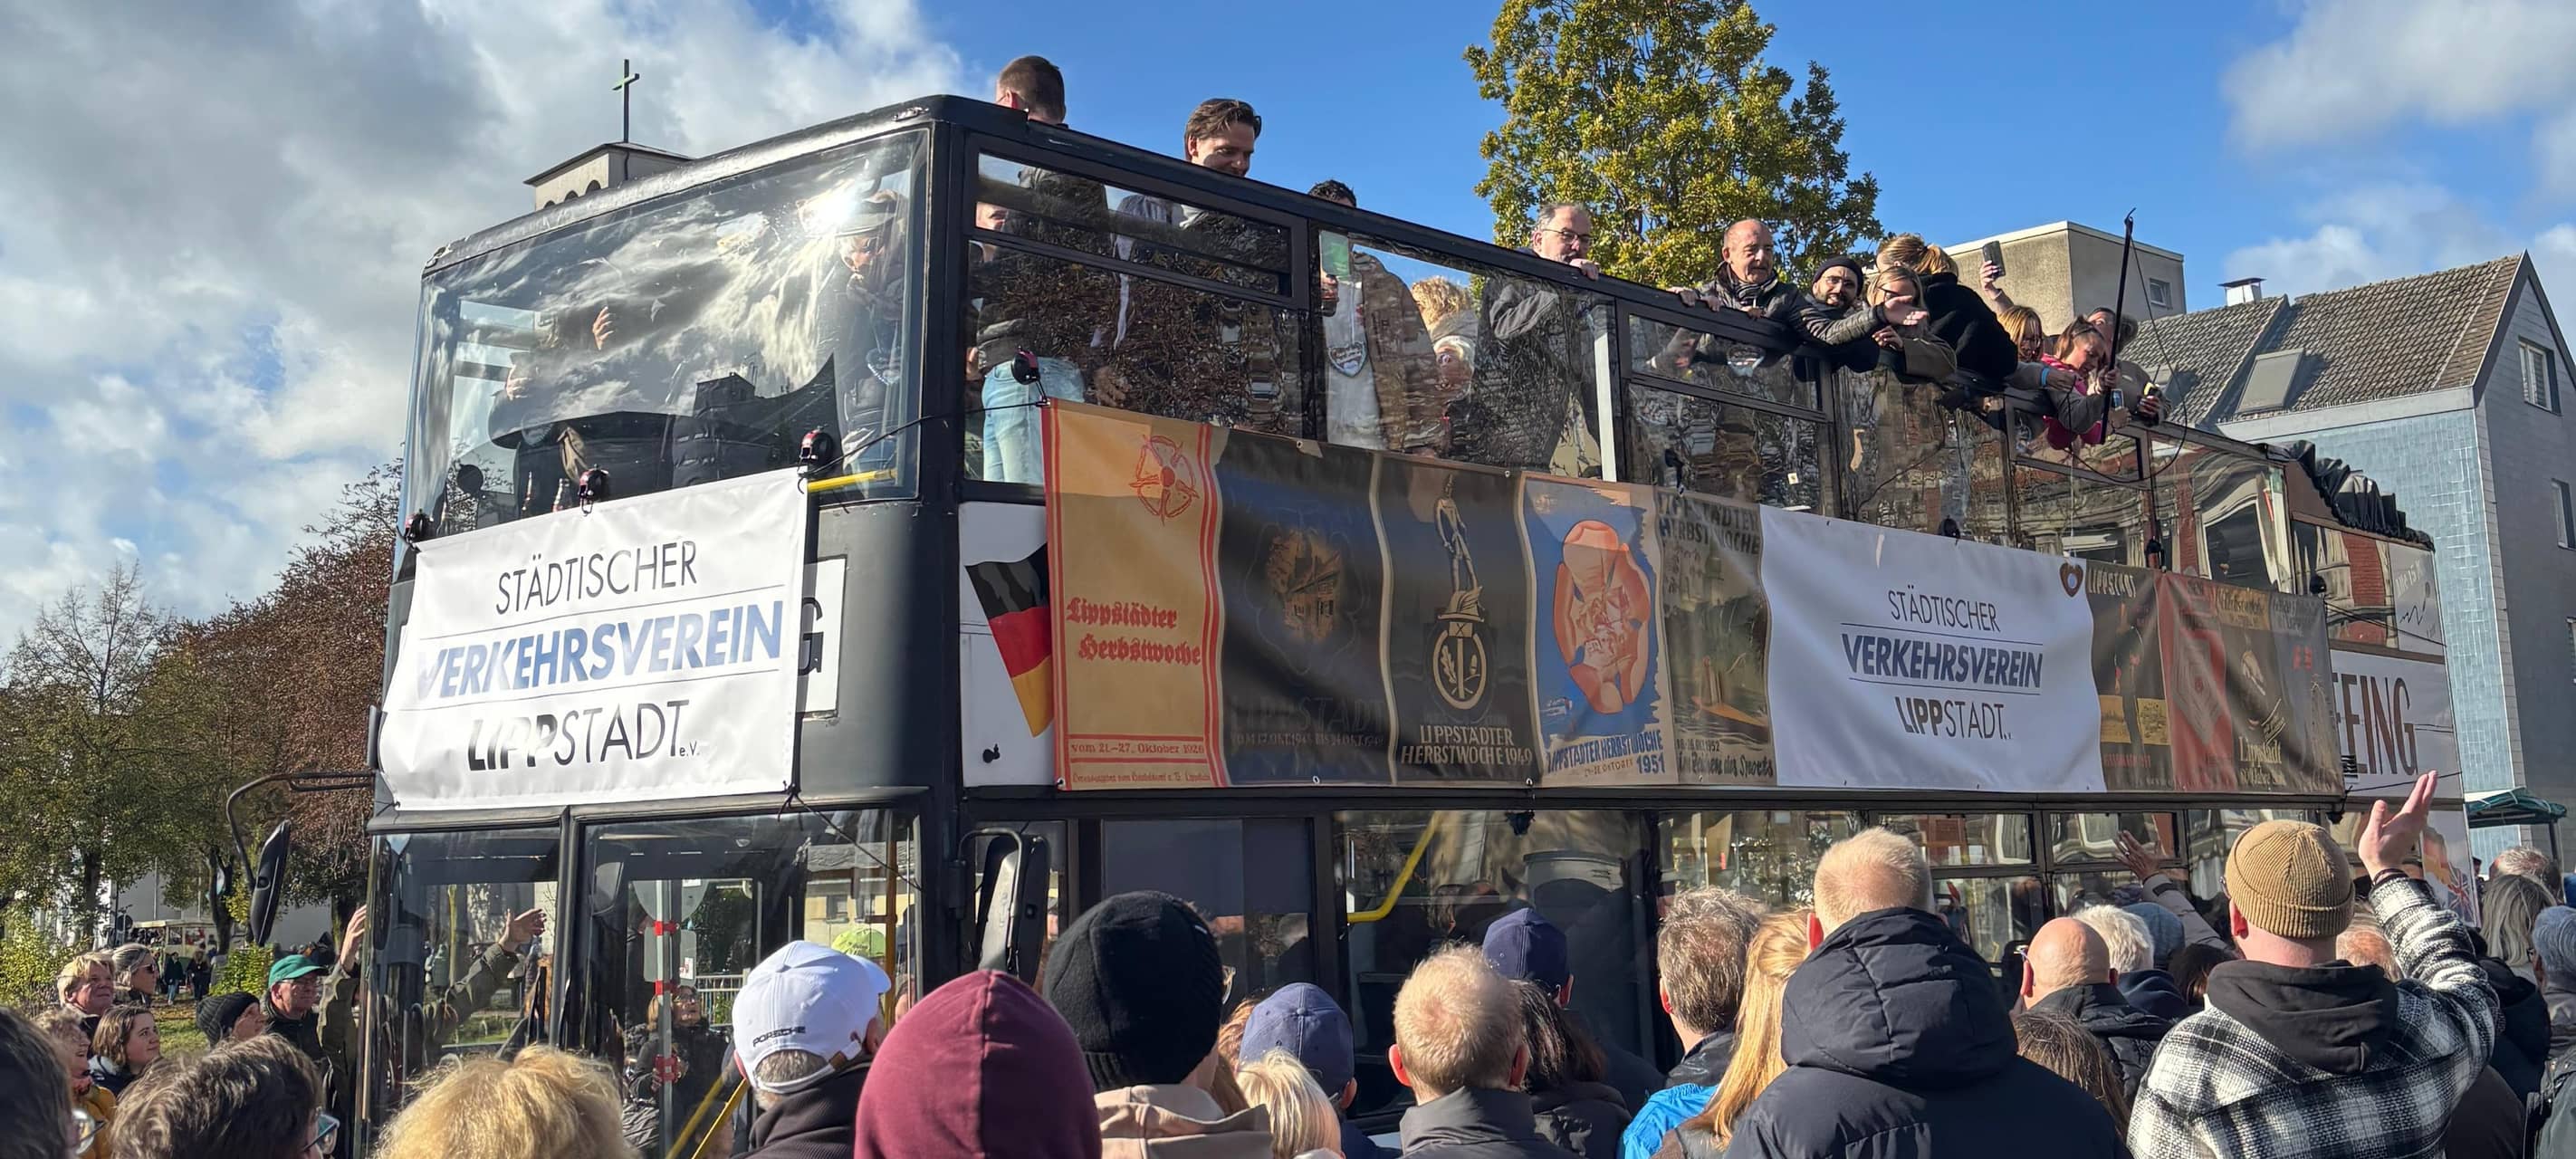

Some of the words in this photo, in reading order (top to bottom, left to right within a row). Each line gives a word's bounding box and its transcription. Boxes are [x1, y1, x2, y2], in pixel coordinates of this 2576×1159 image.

[495, 541, 697, 615] STÄDTISCHER
[2086, 566, 2137, 599] LIPPSTADT
[1066, 596, 1177, 630] Lippstädter
[1888, 585, 2000, 632] STÄDTISCHER
[417, 600, 784, 700] VERKEHRSVEREIN
[1078, 633, 1202, 666] Herbstwoche
[1842, 633, 2043, 688] VERKEHRSVEREIN
[1894, 696, 2004, 740] LIPPSTADT
[467, 700, 689, 772] LIPPSTADT
[679, 741, 701, 757] e.V.
[1071, 743, 1096, 753] vom
[1137, 742, 1179, 754] Oktober
[1420, 724, 1515, 746] LIPPSTÄDTER
[1401, 744, 1504, 765] HERBSTWOCHE
[1637, 752, 1665, 774] 1951
[752, 1024, 807, 1048] PORSCHE
